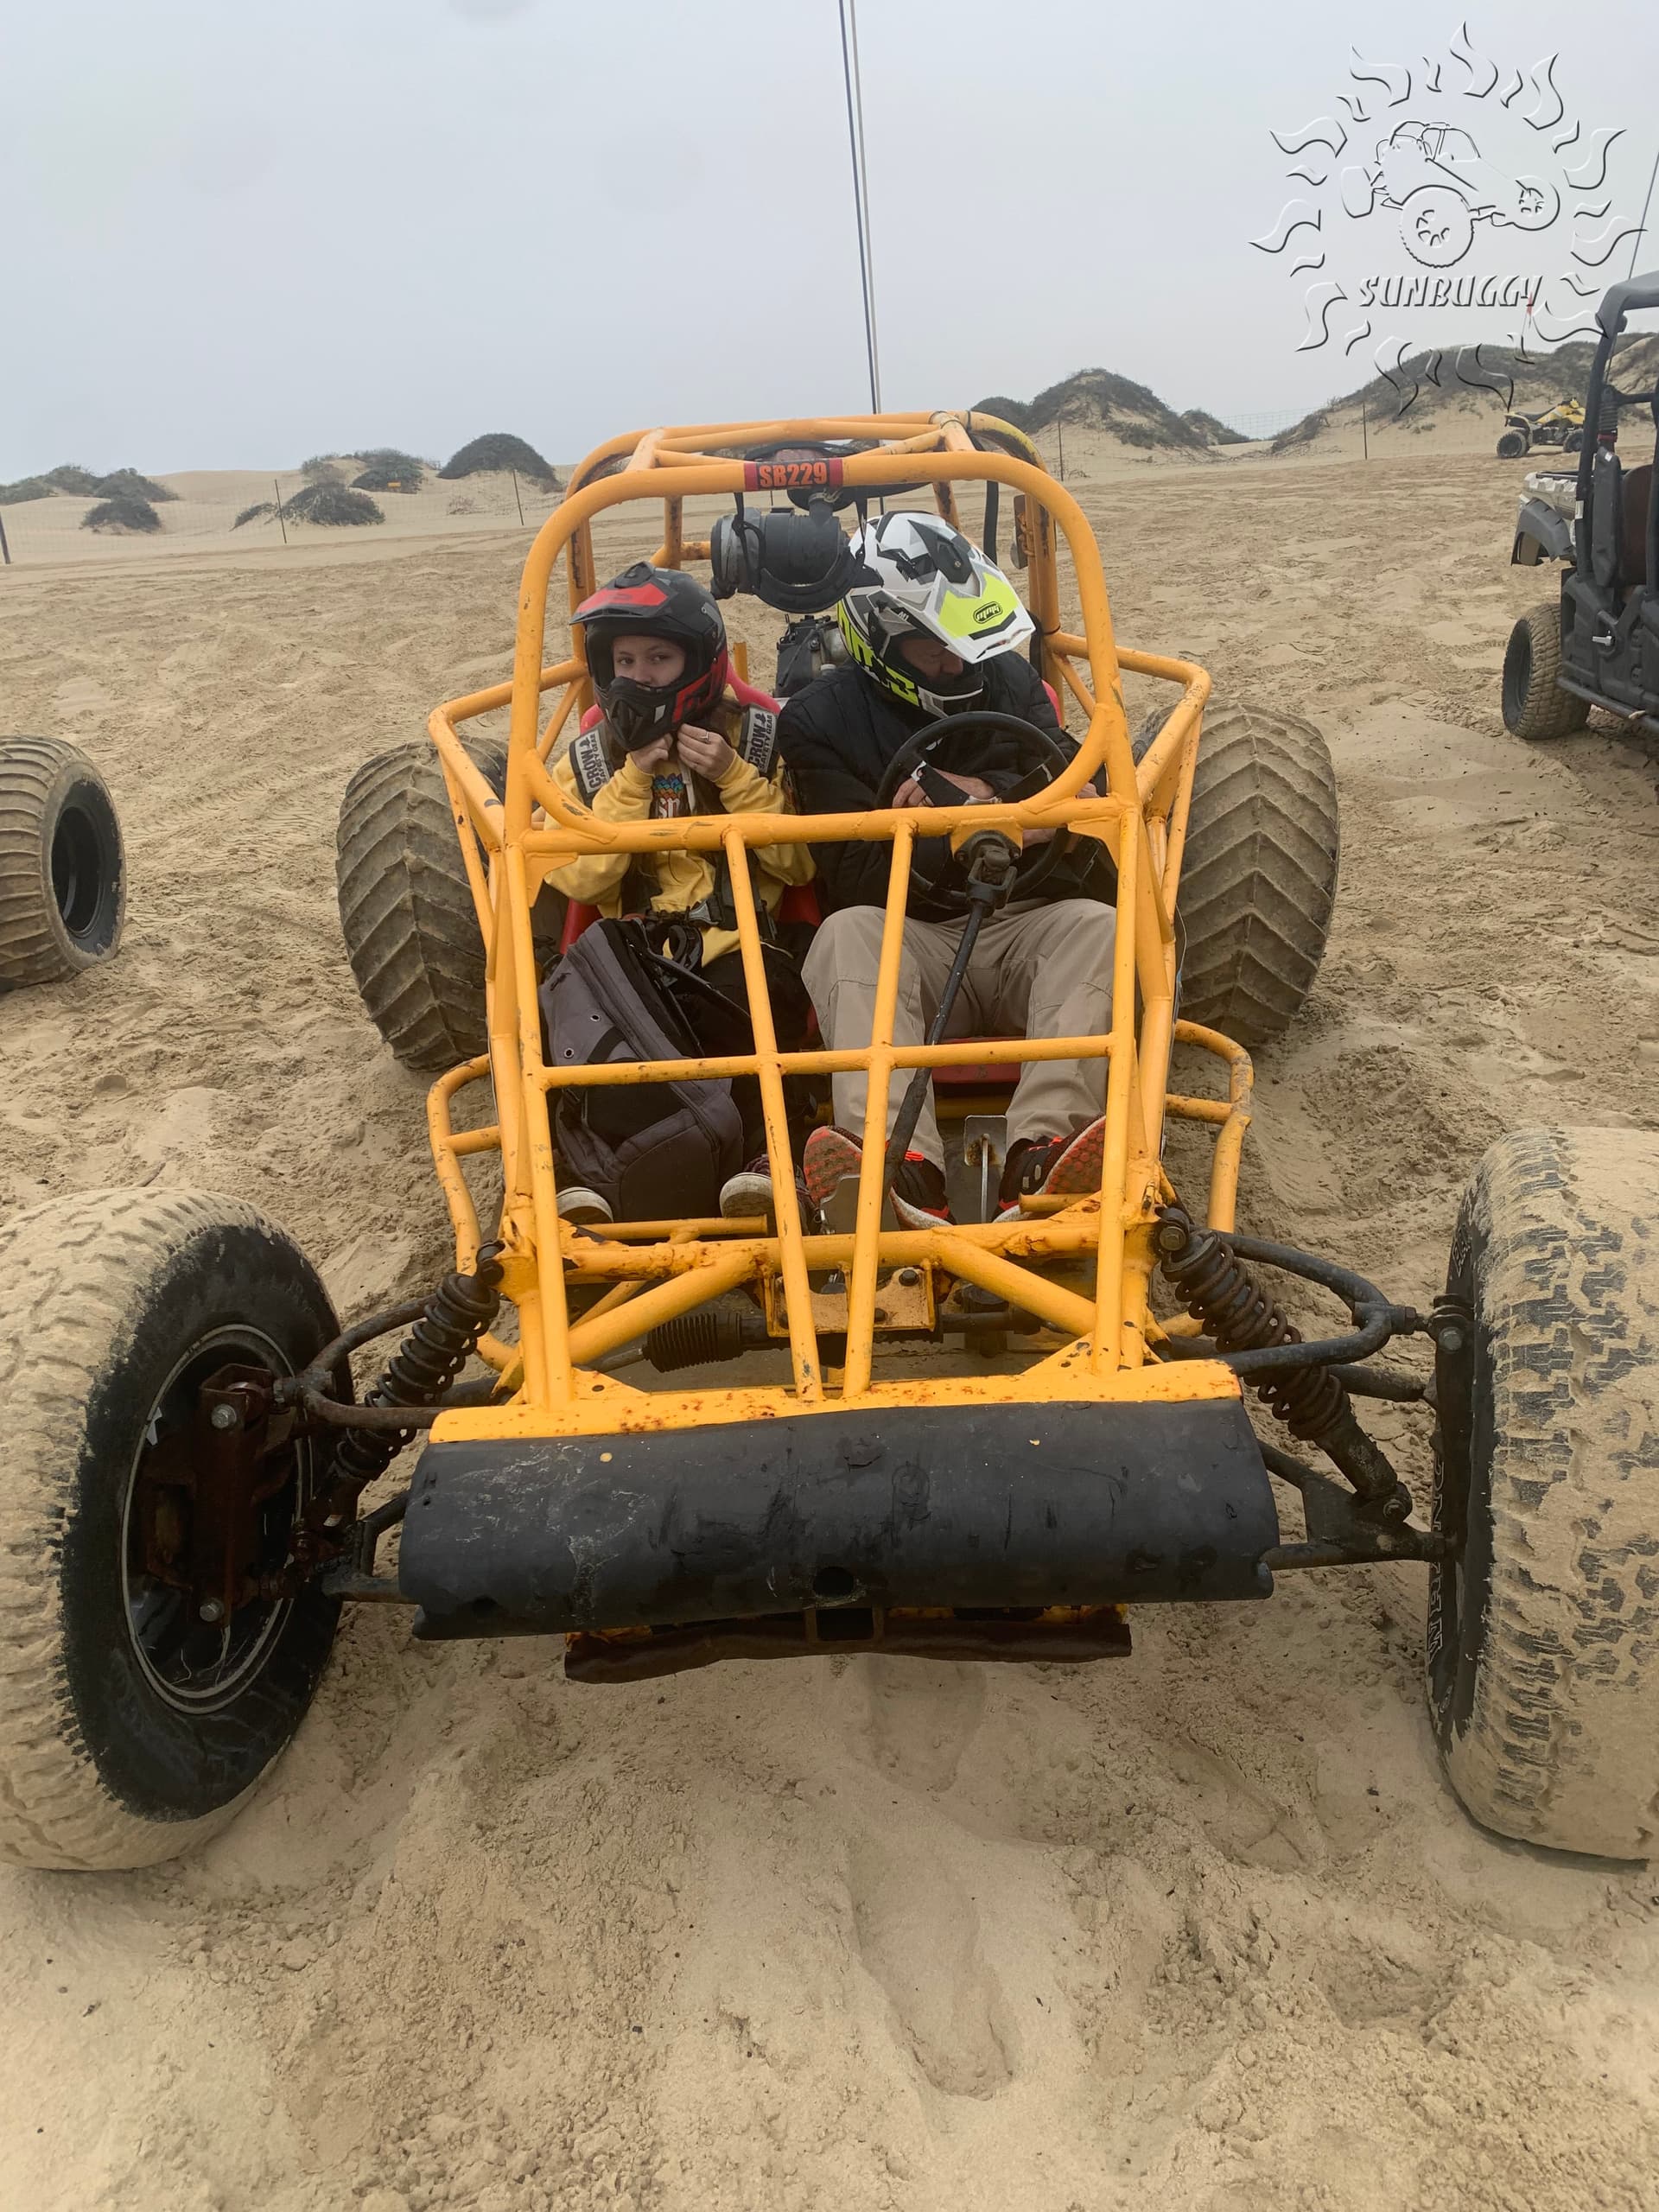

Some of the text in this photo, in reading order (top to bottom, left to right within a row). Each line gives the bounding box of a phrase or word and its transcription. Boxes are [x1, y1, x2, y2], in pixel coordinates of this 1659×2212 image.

[759, 462, 828, 487] SB229
[581, 749, 601, 788] CROW
[760, 735, 771, 769] SAFETY
